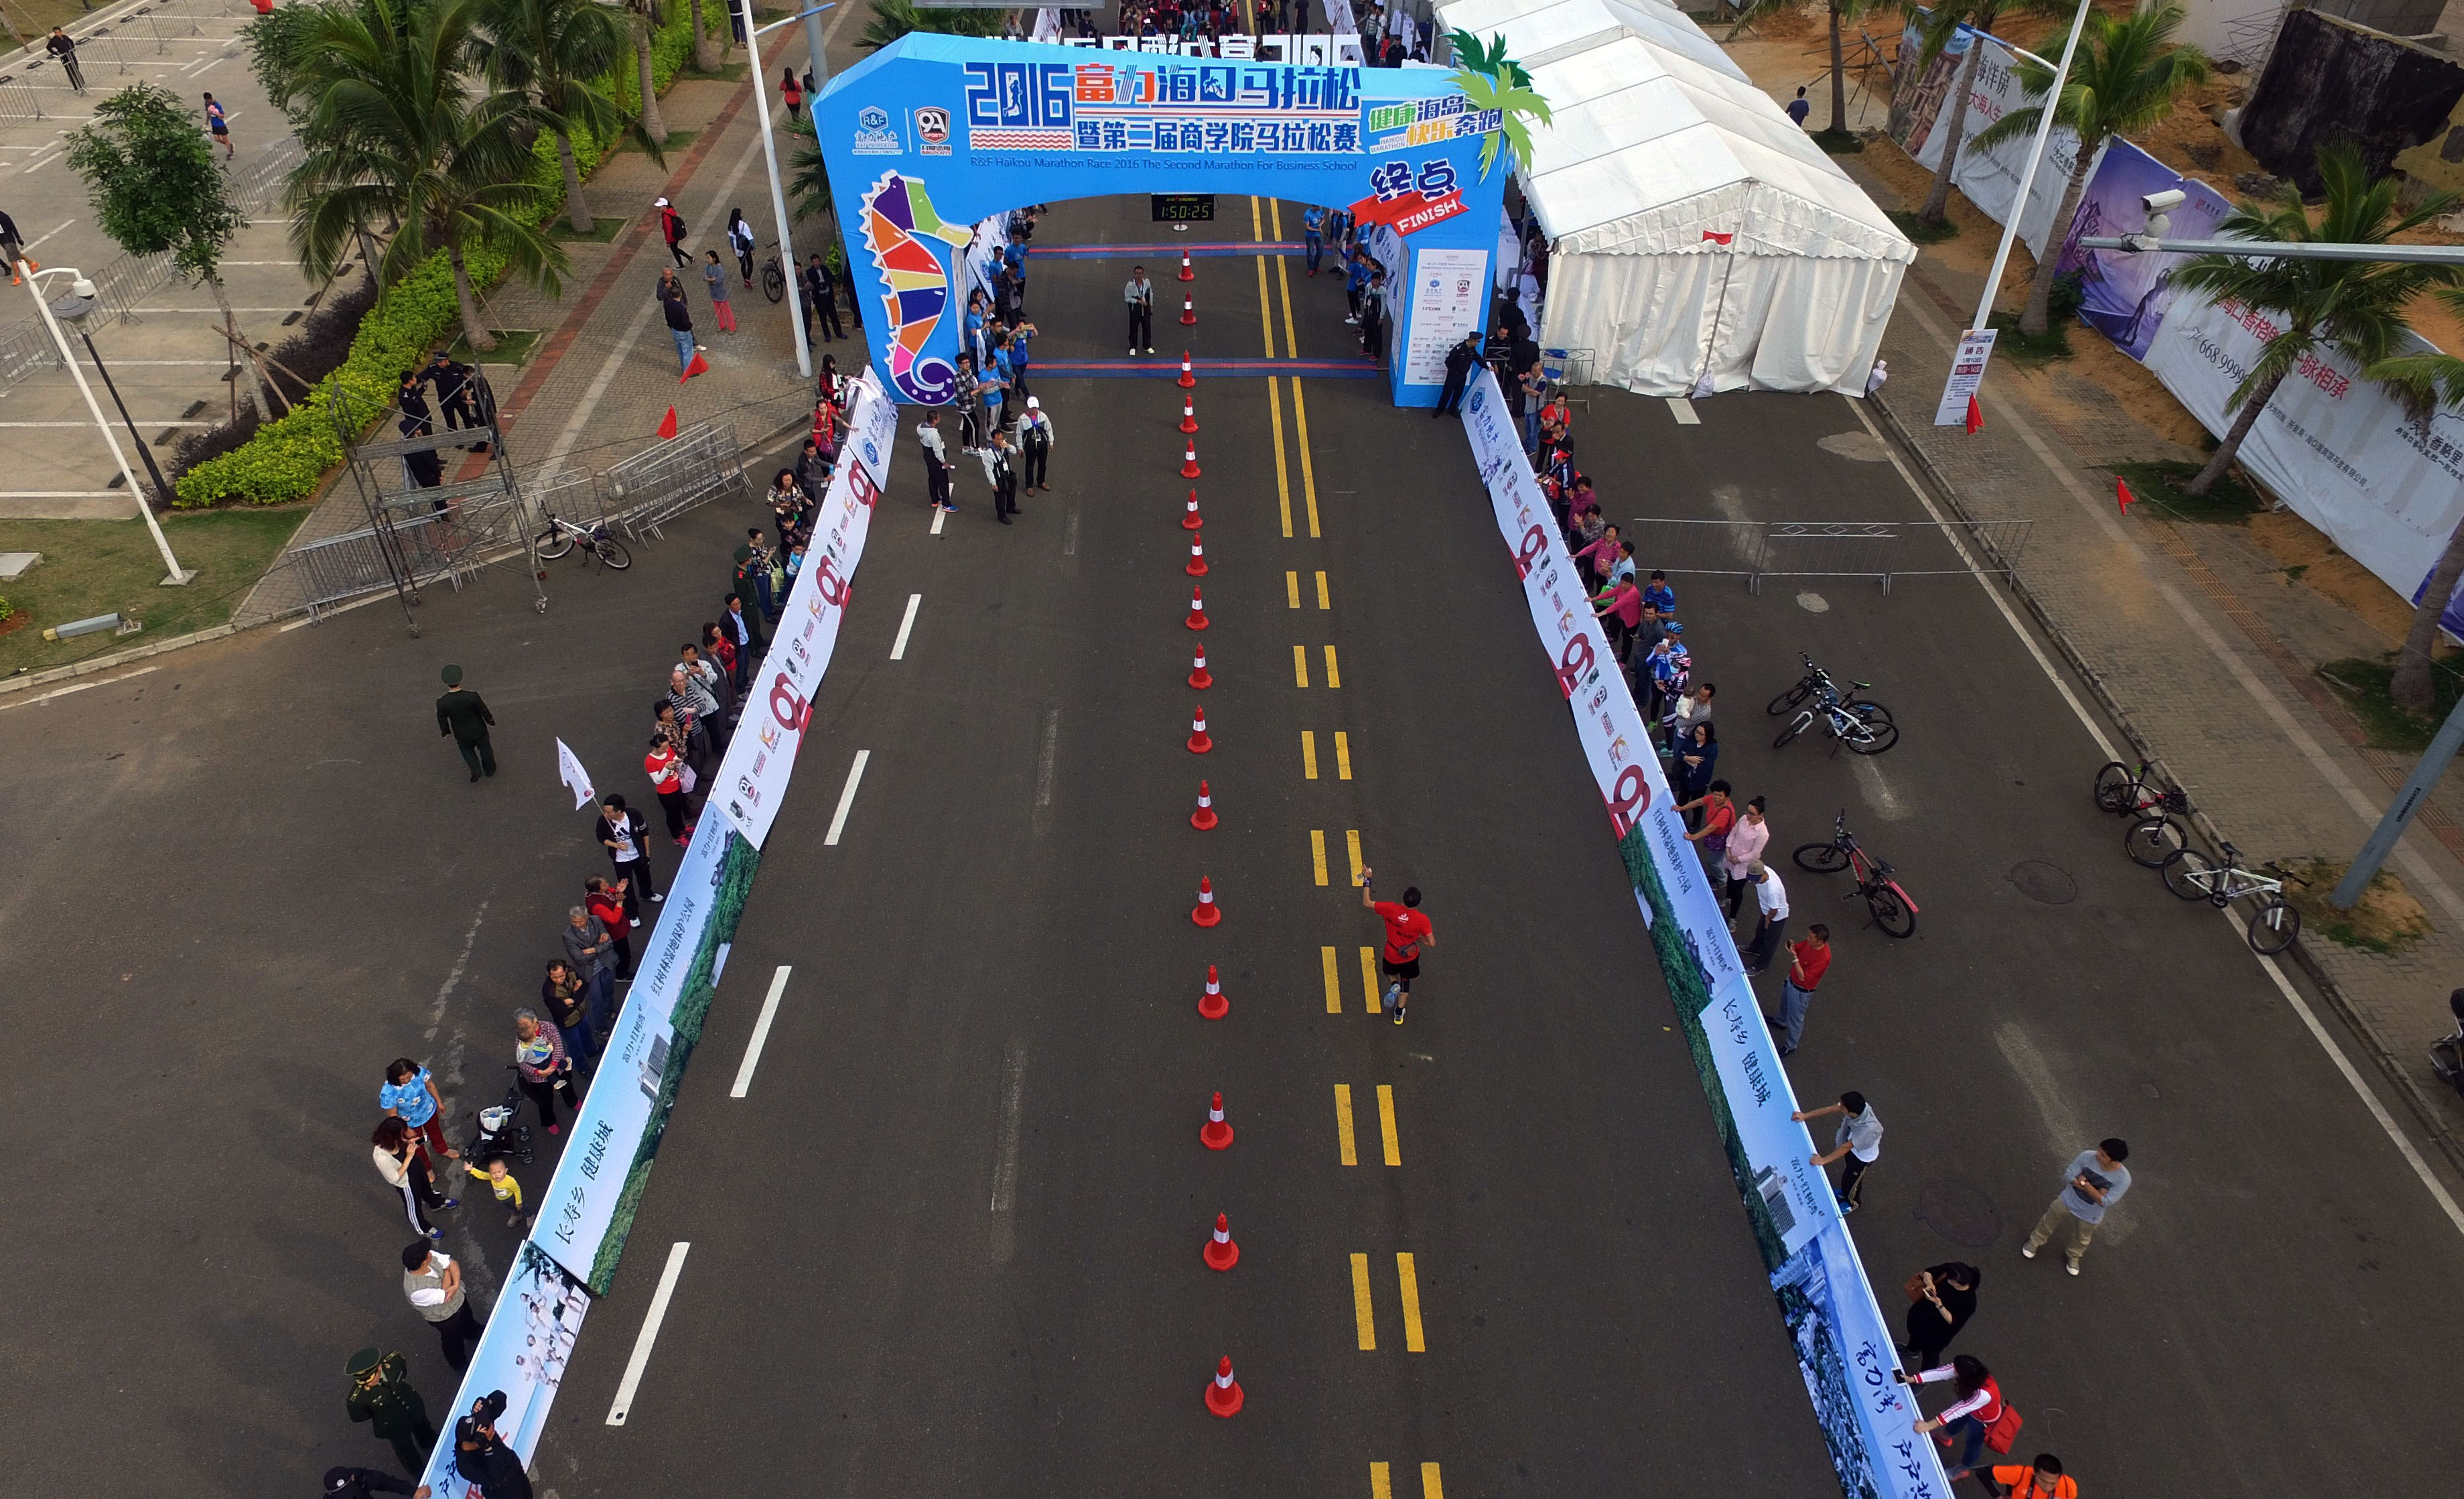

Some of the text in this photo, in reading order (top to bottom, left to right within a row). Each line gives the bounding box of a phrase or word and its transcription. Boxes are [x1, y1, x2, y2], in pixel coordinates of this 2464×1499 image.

[965, 62, 1072, 127] 2016
[1370, 95, 1465, 131] 健康海岛
[1408, 107, 1503, 146] 快乐奔跑
[1077, 119, 1359, 151] 暨第二届商学院马拉松赛
[1371, 141, 1406, 153] MARATHON
[1381, 136, 1404, 145] HAIKOU
[971, 156, 1357, 170] R&F Haikou Marathon Race 2016 The Second Marathon For Business School
[1397, 198, 1458, 233] FINISH
[2199, 339, 2220, 363] 668
[1722, 998, 1771, 1108] 长寿乡 健康城
[555, 1120, 614, 1245] 长寿乡 健康城
